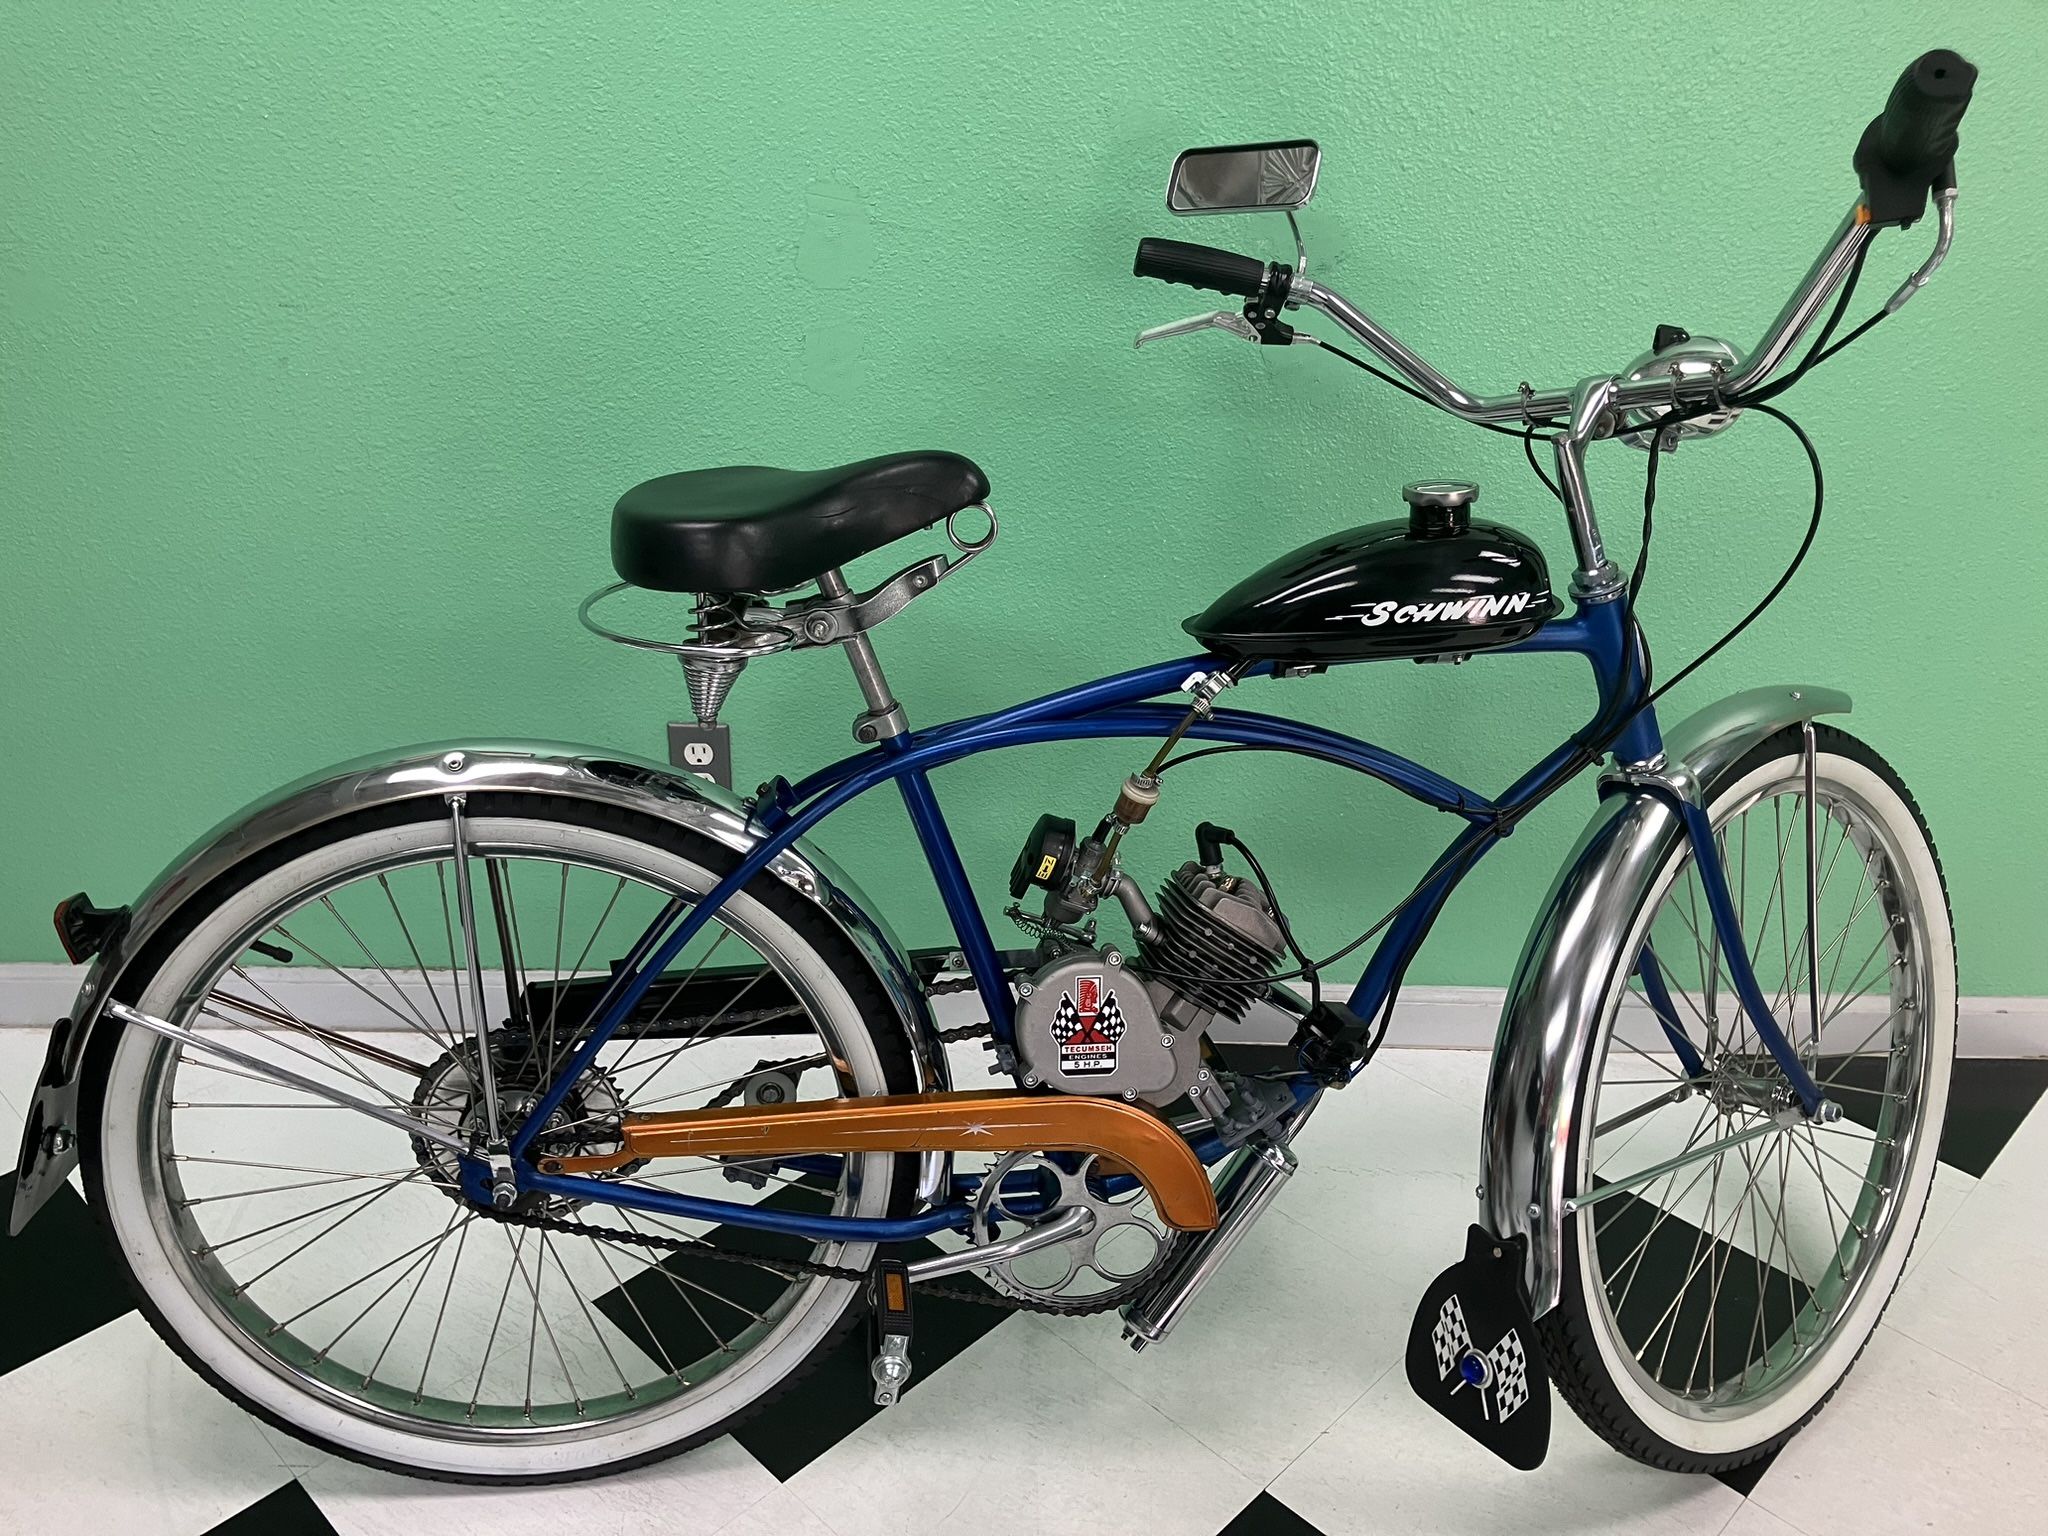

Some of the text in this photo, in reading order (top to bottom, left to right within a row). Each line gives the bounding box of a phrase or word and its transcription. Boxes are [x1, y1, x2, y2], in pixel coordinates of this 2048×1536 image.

[1360, 592, 1531, 627] SCHWINN
[1064, 1045, 1112, 1053] TECUMSEH
[1074, 1060, 1081, 1069] 5
